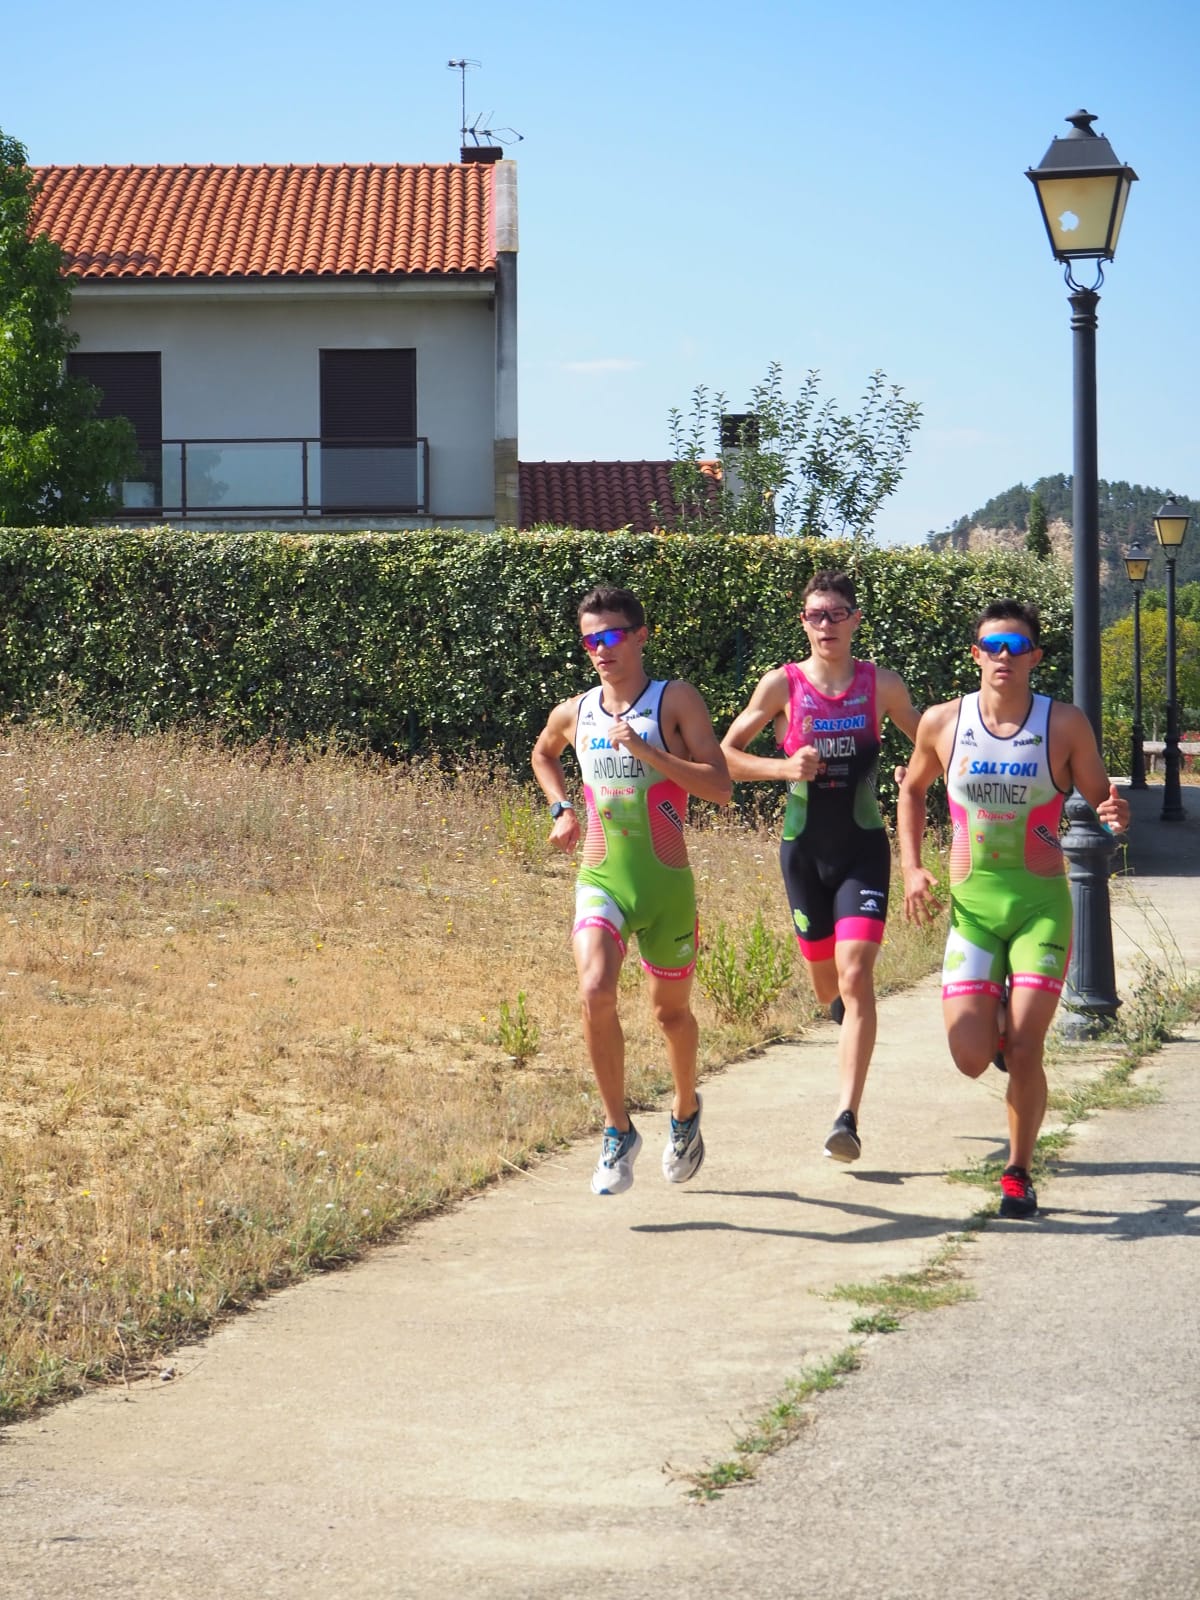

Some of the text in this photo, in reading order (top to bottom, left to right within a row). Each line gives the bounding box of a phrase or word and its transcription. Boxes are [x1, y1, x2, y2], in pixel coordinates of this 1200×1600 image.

[812, 714, 866, 732] SALTOKI
[589, 731, 648, 750] SALI
[593, 755, 645, 779] ANDUEZA
[969, 761, 1038, 777] SALTOKI
[966, 783, 1028, 805] MARTINEZ
